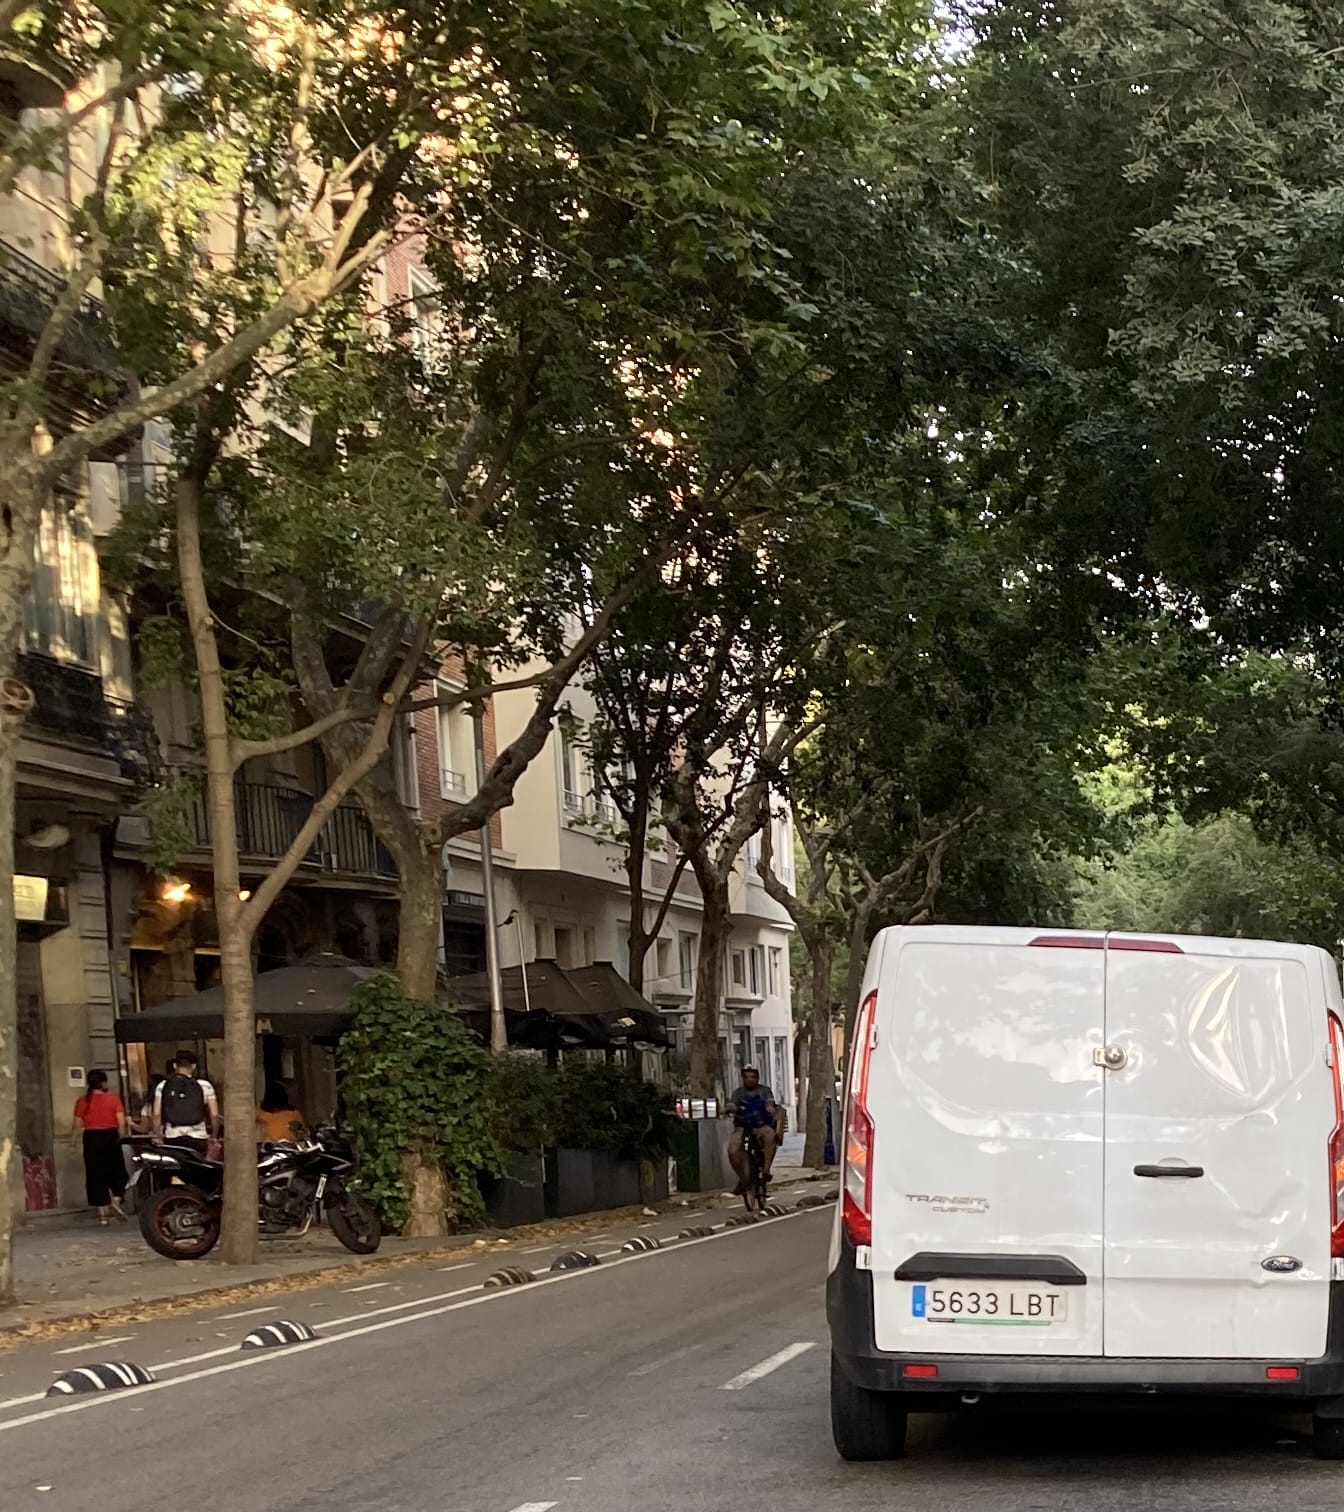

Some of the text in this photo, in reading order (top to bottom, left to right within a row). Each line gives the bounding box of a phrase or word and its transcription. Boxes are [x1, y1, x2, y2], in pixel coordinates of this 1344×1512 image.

[905, 1194, 987, 1205] TRANSIT
[932, 1290, 1060, 1317] 5633 LBT
